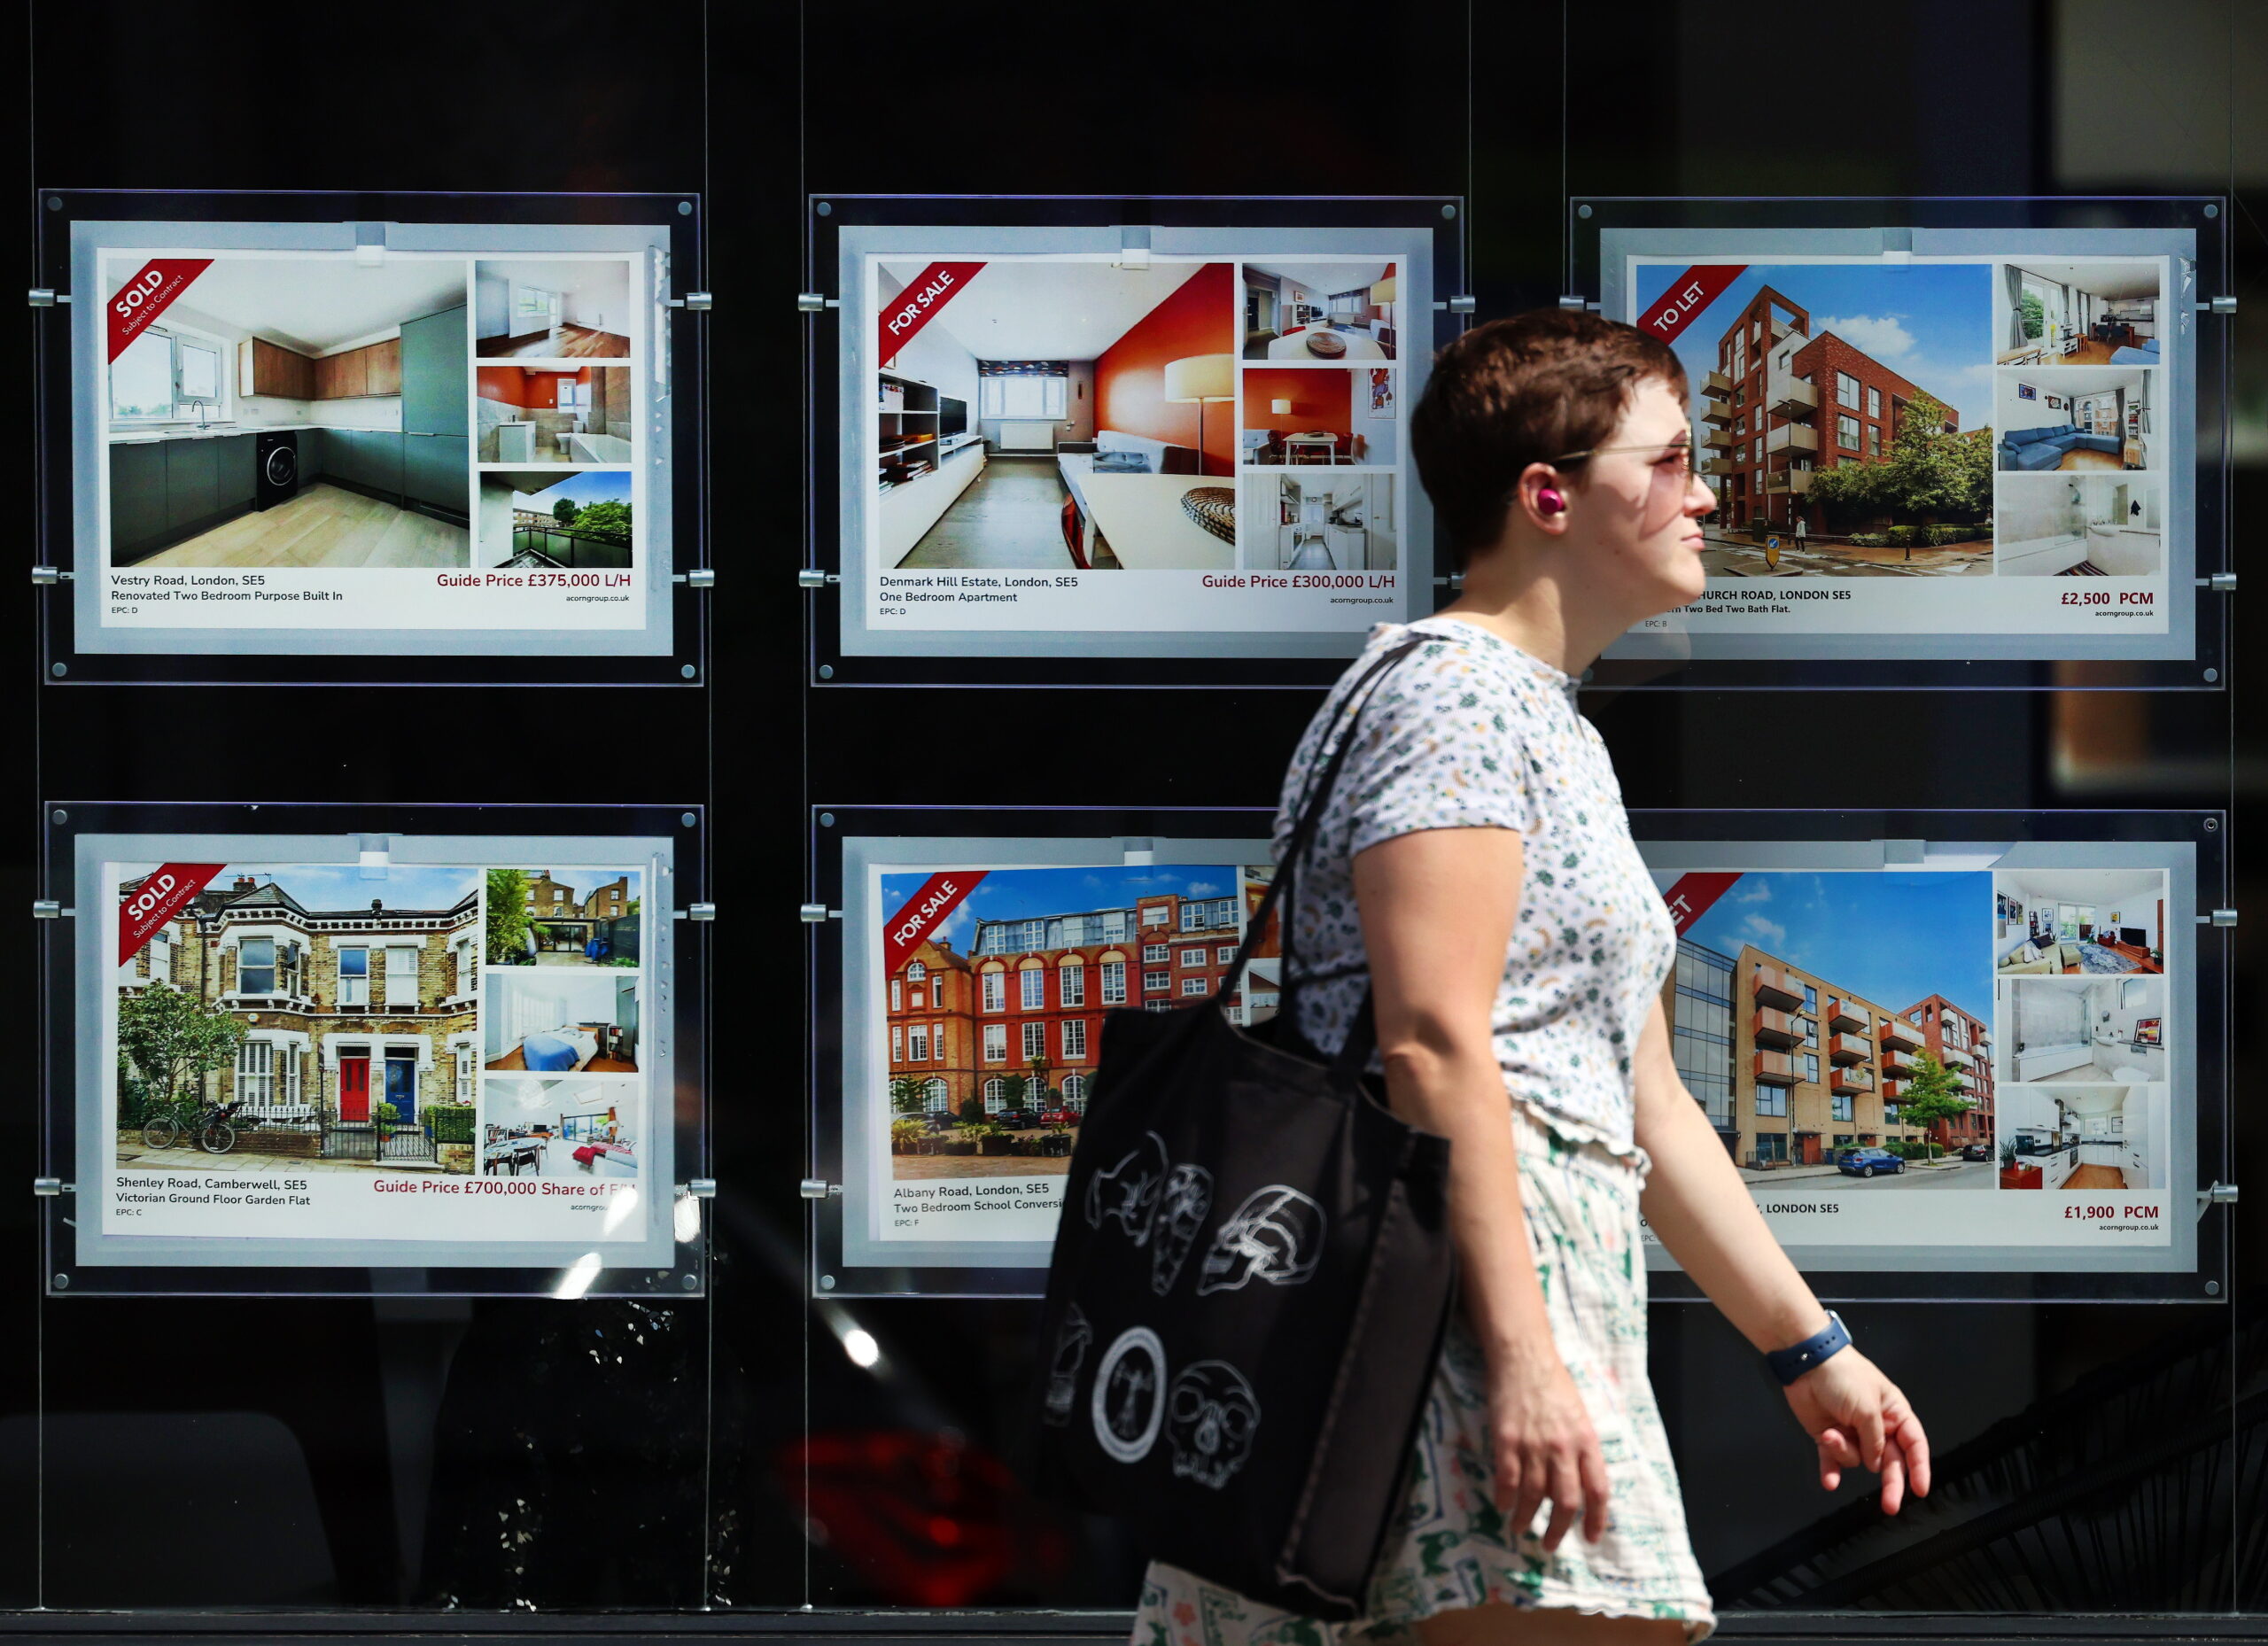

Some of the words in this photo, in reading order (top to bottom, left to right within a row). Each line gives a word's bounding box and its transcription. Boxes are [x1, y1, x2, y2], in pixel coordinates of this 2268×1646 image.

[115, 270, 163, 318] SOLD
[122, 310, 149, 336] Subject
[146, 303, 155, 312] to
[153, 275, 184, 303] Contract
[888, 303, 922, 336] FOR
[916, 270, 955, 308] SALE
[1653, 308, 1680, 331] TO
[1675, 281, 1705, 312] LET
[111, 575, 150, 586] Vestry
[154, 575, 187, 586] Road,
[191, 575, 238, 586] London,
[242, 576, 265, 586] SE5
[437, 574, 480, 586] Guide
[486, 574, 523, 586] Price
[528, 574, 600, 588] £375,000
[605, 574, 631, 587] L/H
[880, 577, 933, 586] Denmark
[936, 577, 958, 586] Hill
[961, 577, 1001, 587] Estate,
[1006, 577, 1052, 588] London,
[1055, 577, 1078, 586] SE5
[1202, 575, 1246, 587] Guide
[1251, 575, 1287, 587] Price
[1293, 575, 1363, 589] £300,000
[1369, 575, 1395, 588] L/H
[112, 591, 170, 601] Renovated
[174, 591, 198, 601] Two
[201, 591, 251, 601] Bedroom
[255, 591, 299, 602] Purpose
[303, 591, 330, 601] Built
[333, 591, 343, 601] In
[880, 593, 902, 602] One
[905, 593, 955, 602] Bedroom
[959, 593, 1018, 603] Apartment
[1697, 591, 1737, 600] HURCH
[1741, 591, 1775, 602] ROAD,
[1781, 591, 1829, 600] LONDON
[1832, 591, 1851, 600] SE5
[2062, 593, 2110, 607] £2,500
[2120, 593, 2154, 604] PCM
[128, 873, 175, 921] SOLD
[133, 913, 160, 938] Subject
[159, 906, 167, 915] to
[166, 879, 197, 907] Contract
[893, 914, 927, 947] FOR
[920, 880, 958, 919] SALE
[1668, 894, 1692, 927] ET
[116, 1177, 164, 1189] Shenley
[168, 1178, 201, 1189] Road,
[205, 1178, 280, 1191] Camberwell,
[284, 1180, 307, 1190] SE5
[374, 1180, 417, 1193] Guide
[423, 1181, 460, 1194] Price
[464, 1181, 536, 1196] £700,000
[541, 1183, 585, 1196] Share
[589, 1184, 605, 1196] of
[894, 1188, 935, 1199] Albany
[939, 1186, 972, 1197] Road,
[975, 1184, 1023, 1196] London,
[1026, 1184, 1049, 1194] SE5
[116, 1192, 166, 1203] Victorian
[169, 1193, 210, 1204] Ground
[214, 1194, 242, 1204] Floor
[245, 1194, 285, 1205] Garden
[289, 1195, 311, 1206] Flat
[895, 1204, 918, 1213] Two
[921, 1202, 971, 1213] Bedroom
[974, 1200, 1011, 1211] School
[1014, 1199, 1062, 1209] Conversi
[1767, 1204, 1816, 1214] LONDON
[1820, 1204, 1839, 1214] SE5
[2064, 1206, 2114, 1220] £1,900
[2124, 1206, 2158, 1218] PCM
